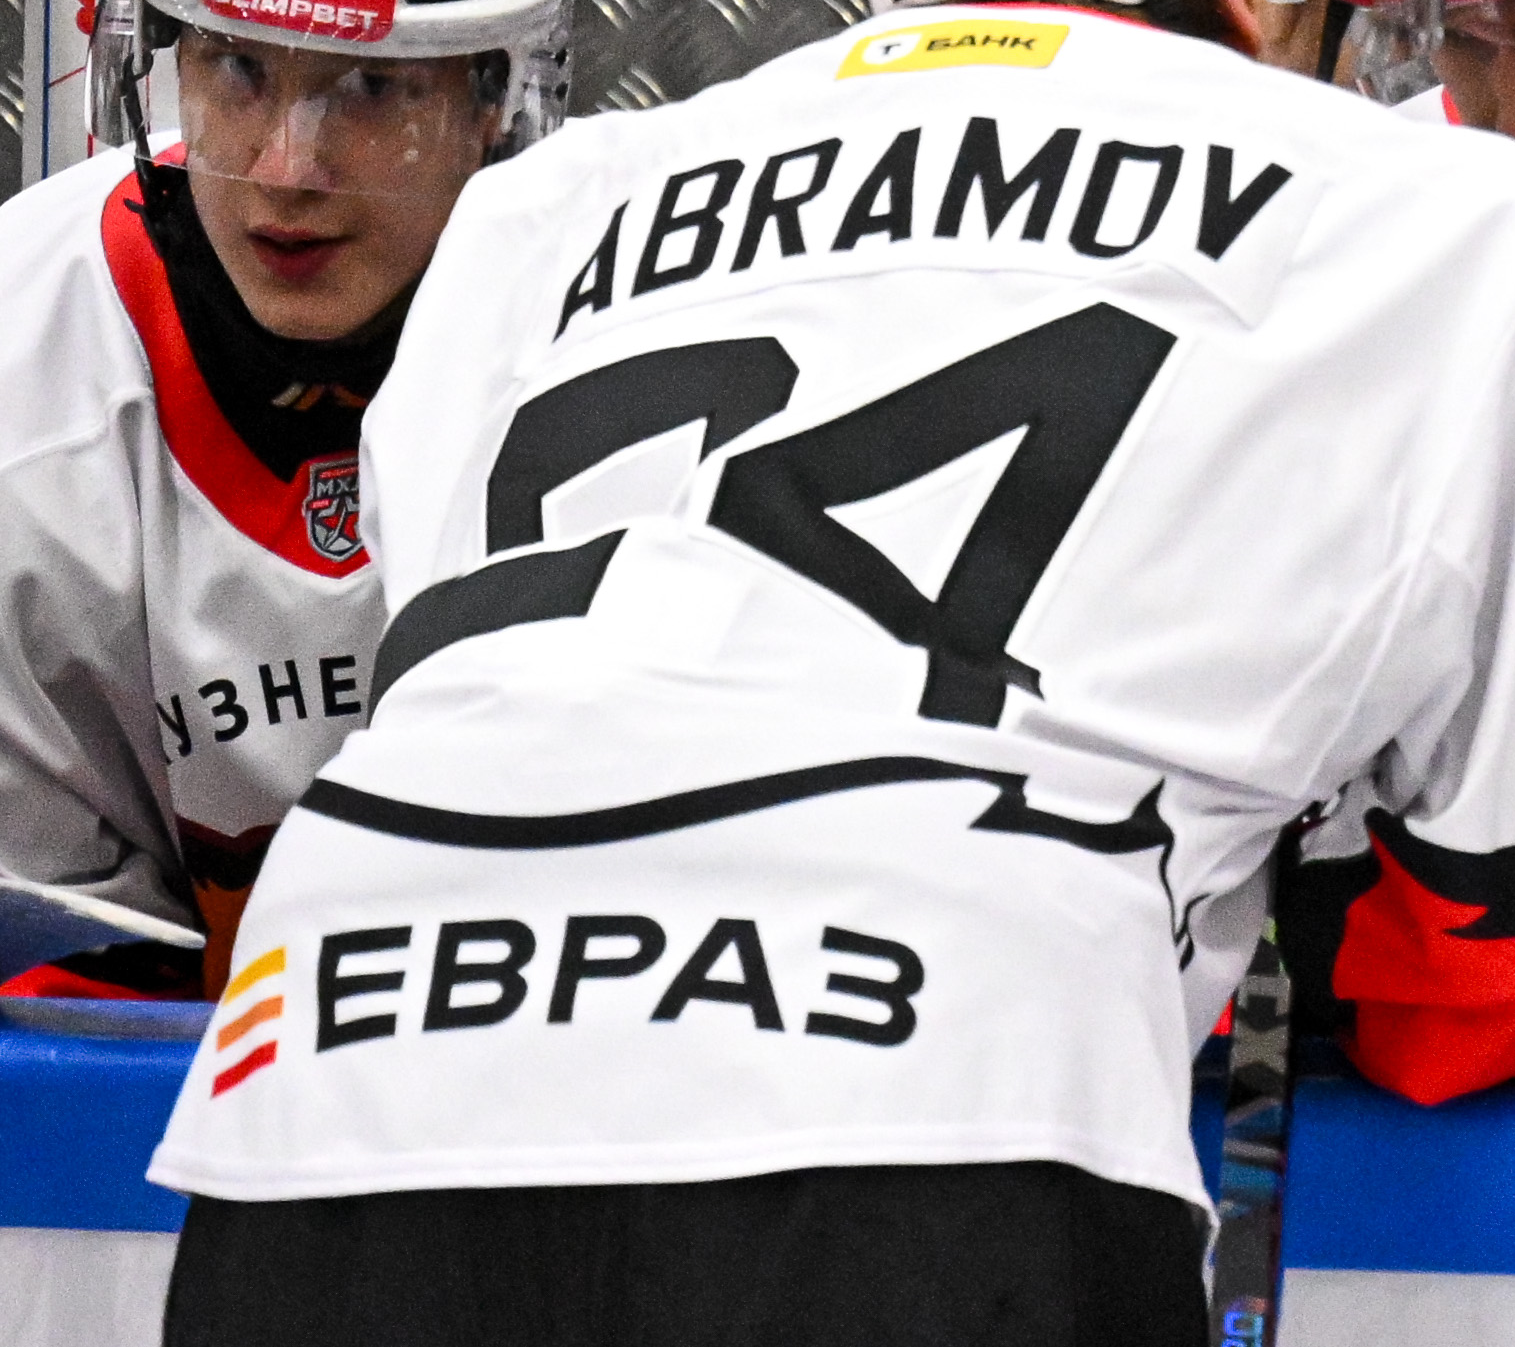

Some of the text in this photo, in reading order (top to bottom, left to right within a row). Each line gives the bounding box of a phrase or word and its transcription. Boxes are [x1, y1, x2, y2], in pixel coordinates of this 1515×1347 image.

[926, 34, 1036, 52] БАНК
[553, 116, 1294, 343] ABRAMOV
[156, 654, 362, 766] УЗНЕ
[314, 914, 926, 1052] ЕВРАЗ
